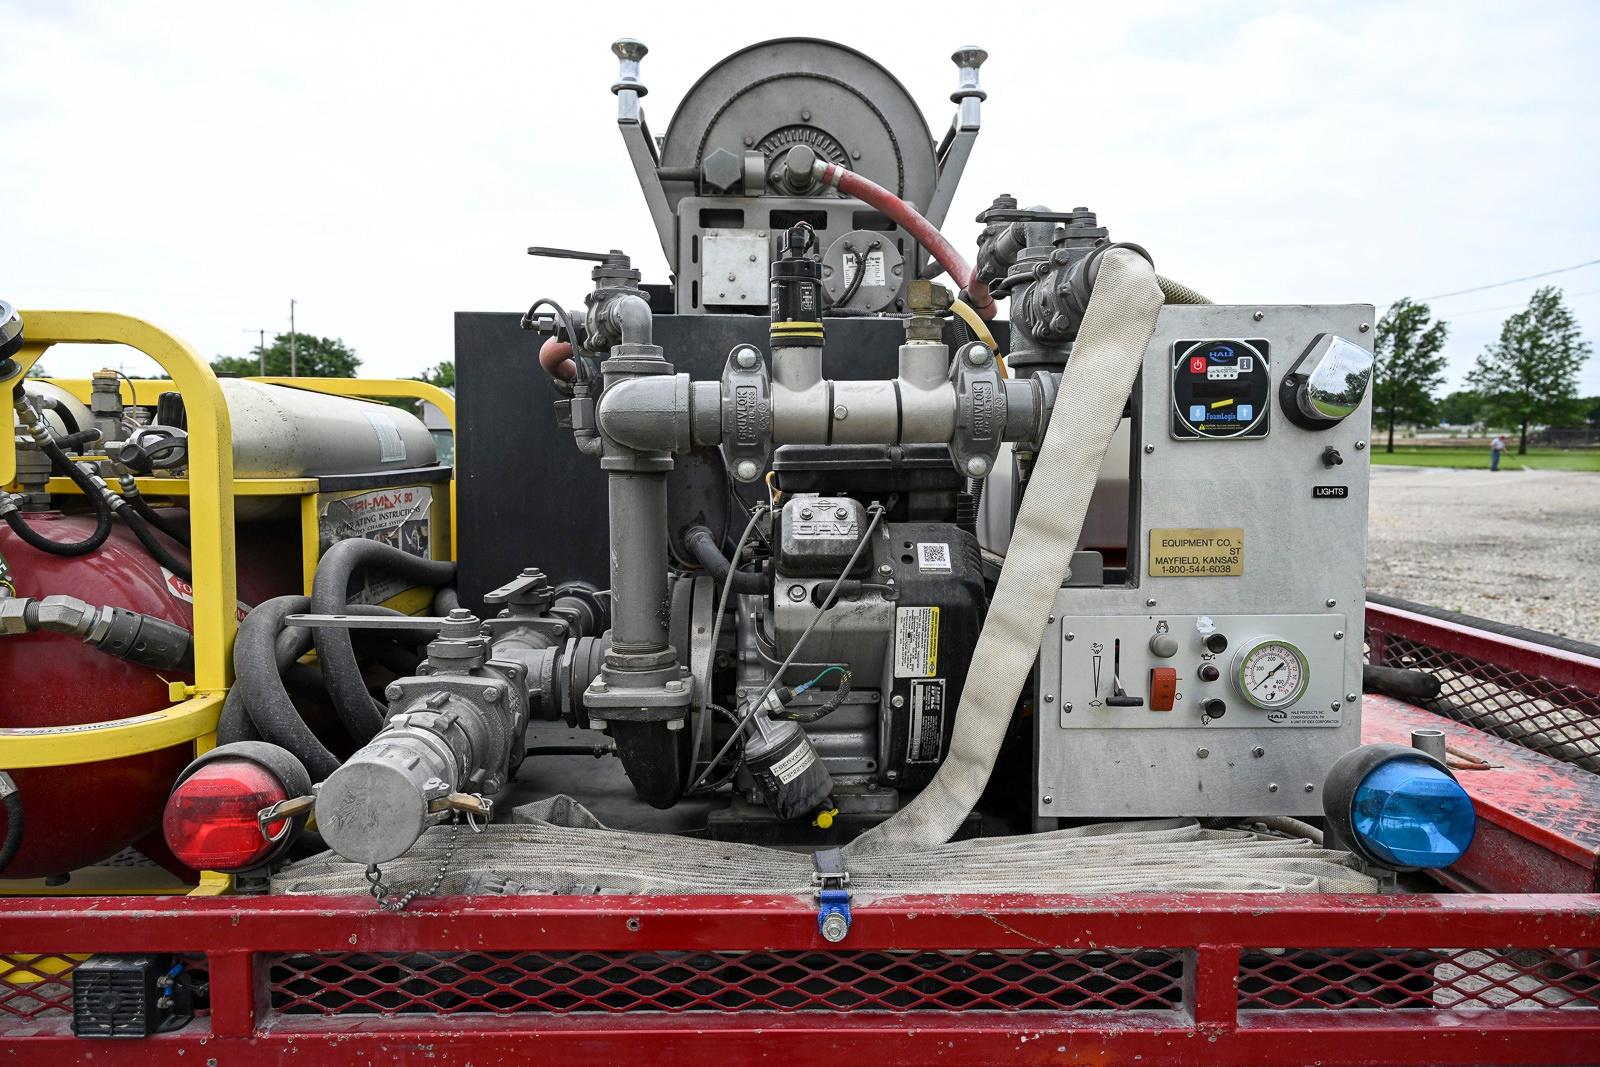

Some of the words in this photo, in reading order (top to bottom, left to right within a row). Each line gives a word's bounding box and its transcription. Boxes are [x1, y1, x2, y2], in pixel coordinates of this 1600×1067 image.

[736, 391, 748, 440] GRUVLOK
[973, 386, 984, 436] GRUVLOK
[1316, 488, 1344, 496] LIGHTS
[1162, 539, 1213, 548] EQUIPMENT
[1216, 538, 1232, 548] CO.
[1229, 547, 1241, 556] ST
[1155, 557, 1201, 565] MAYFIELD,
[1202, 556, 1239, 565] KANSAS
[1161, 566, 1231, 574] 1-800-544-6038
